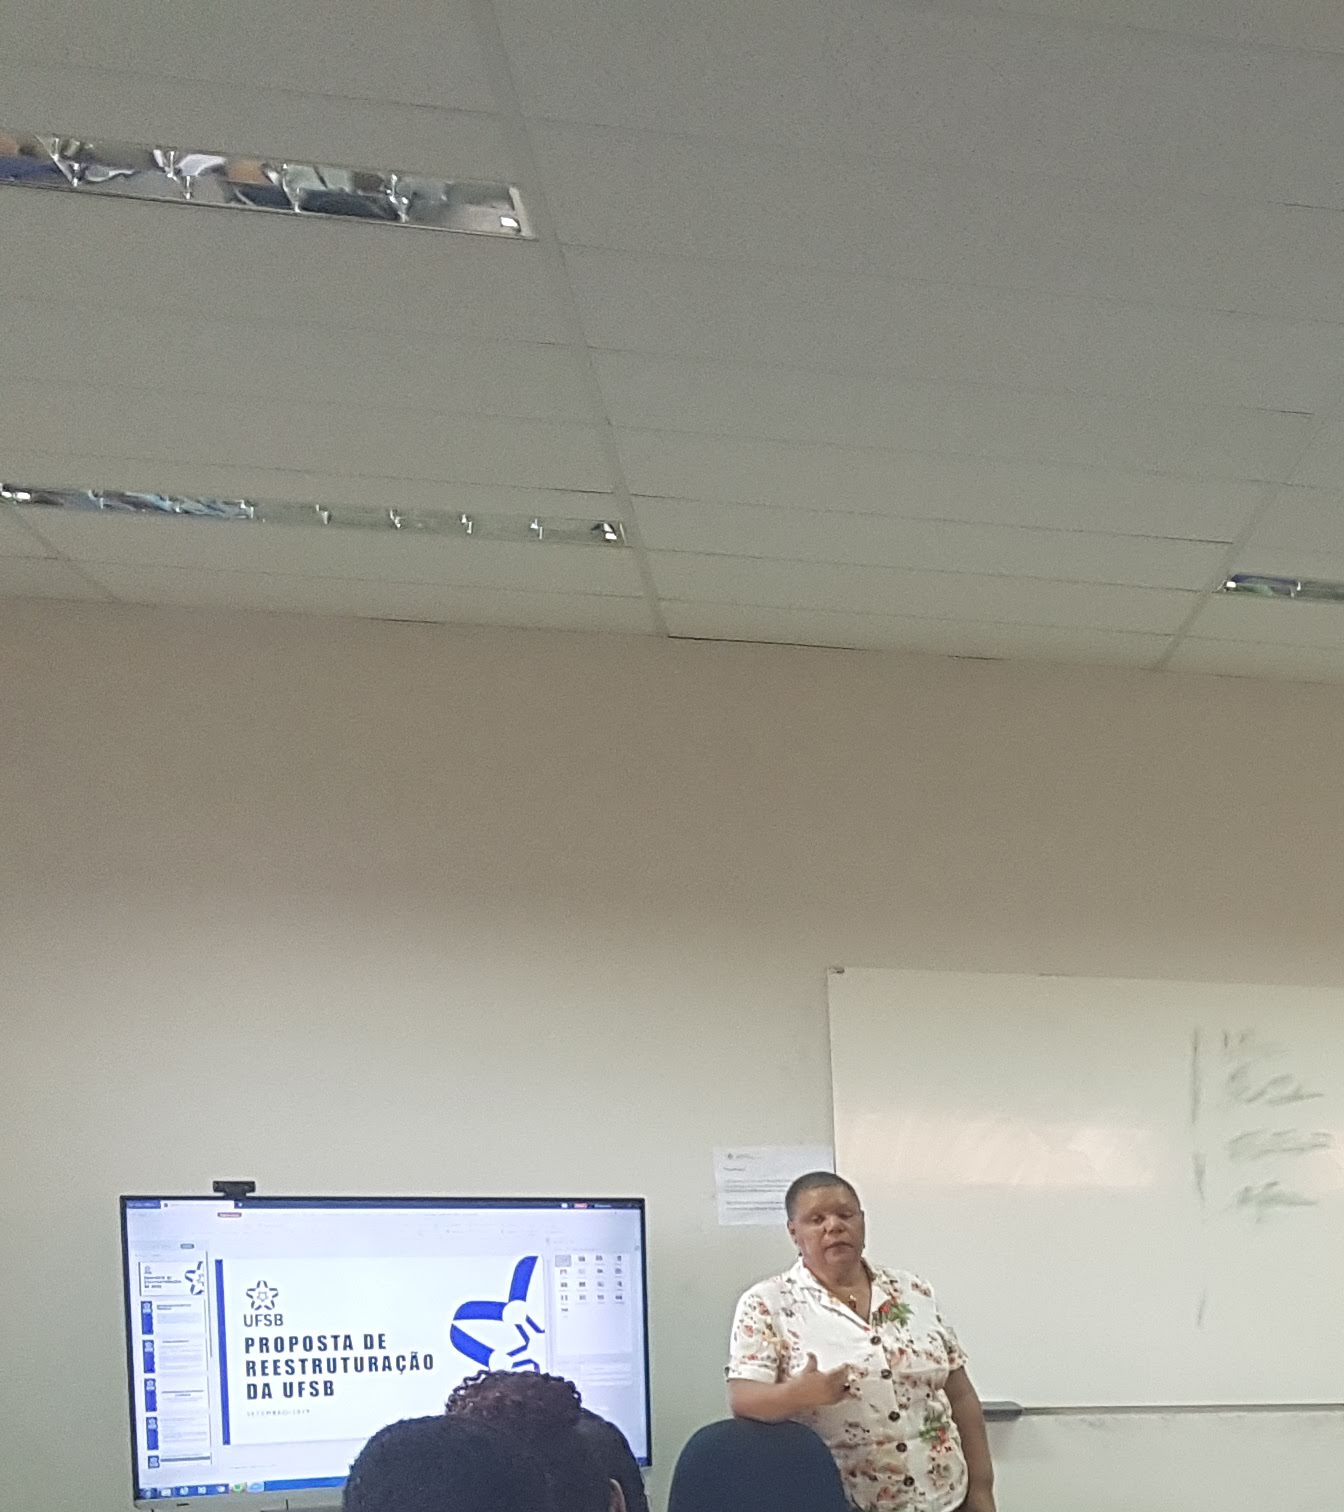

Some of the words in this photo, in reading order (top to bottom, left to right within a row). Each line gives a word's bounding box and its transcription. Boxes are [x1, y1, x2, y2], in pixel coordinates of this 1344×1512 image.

[243, 1313, 284, 1328] UFSB
[244, 1334, 354, 1354] PROPOSTA
[363, 1333, 387, 1350] DE
[246, 1351, 434, 1377] REESTRUTURAÇÃO
[246, 1382, 273, 1400] DA
[282, 1380, 335, 1398] UFSB
